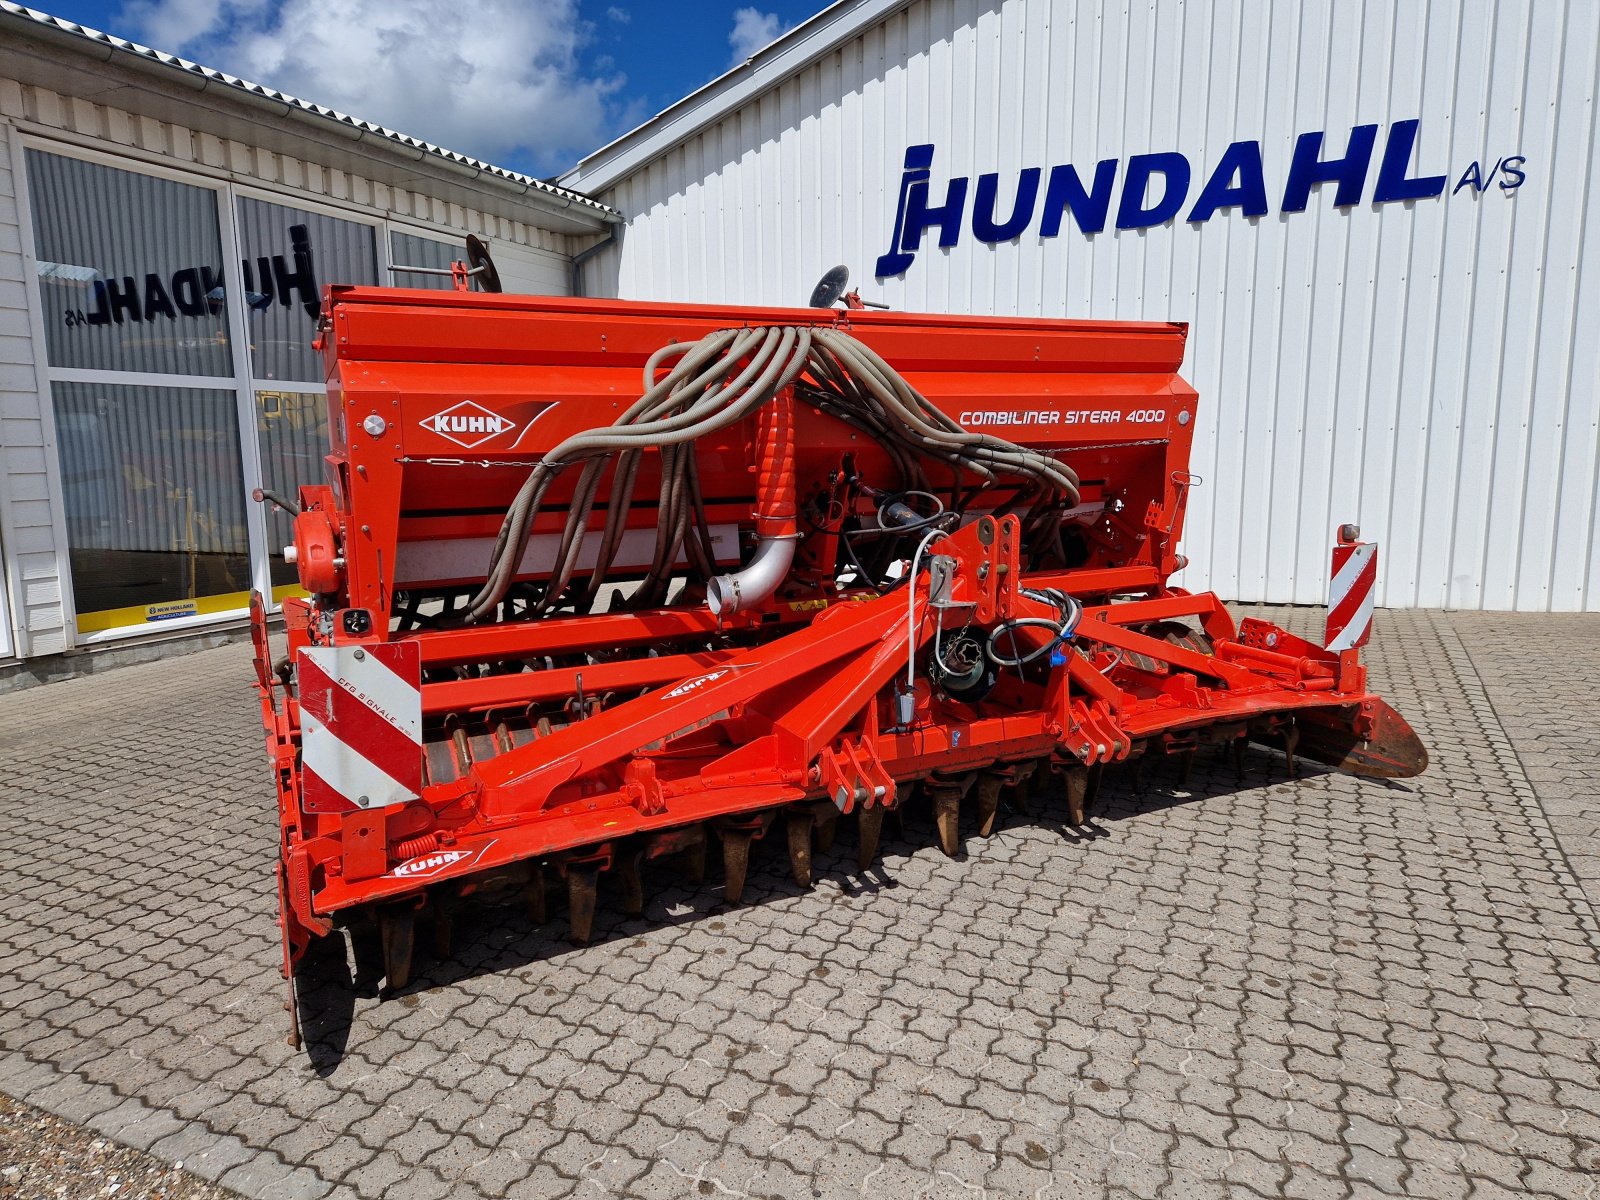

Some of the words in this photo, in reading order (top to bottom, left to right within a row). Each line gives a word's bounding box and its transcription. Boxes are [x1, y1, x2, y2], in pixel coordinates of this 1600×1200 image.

[898, 119, 1447, 251] HUNDAHL
[1453, 156, 1526, 195] A/S
[434, 415, 502, 433] KUHN
[959, 411, 1060, 426] COMBILINER
[1064, 410, 1121, 424] SITERA
[1125, 409, 1166, 423] 4000
[337, 677, 357, 693] CFG
[393, 851, 460, 878] KUHN
